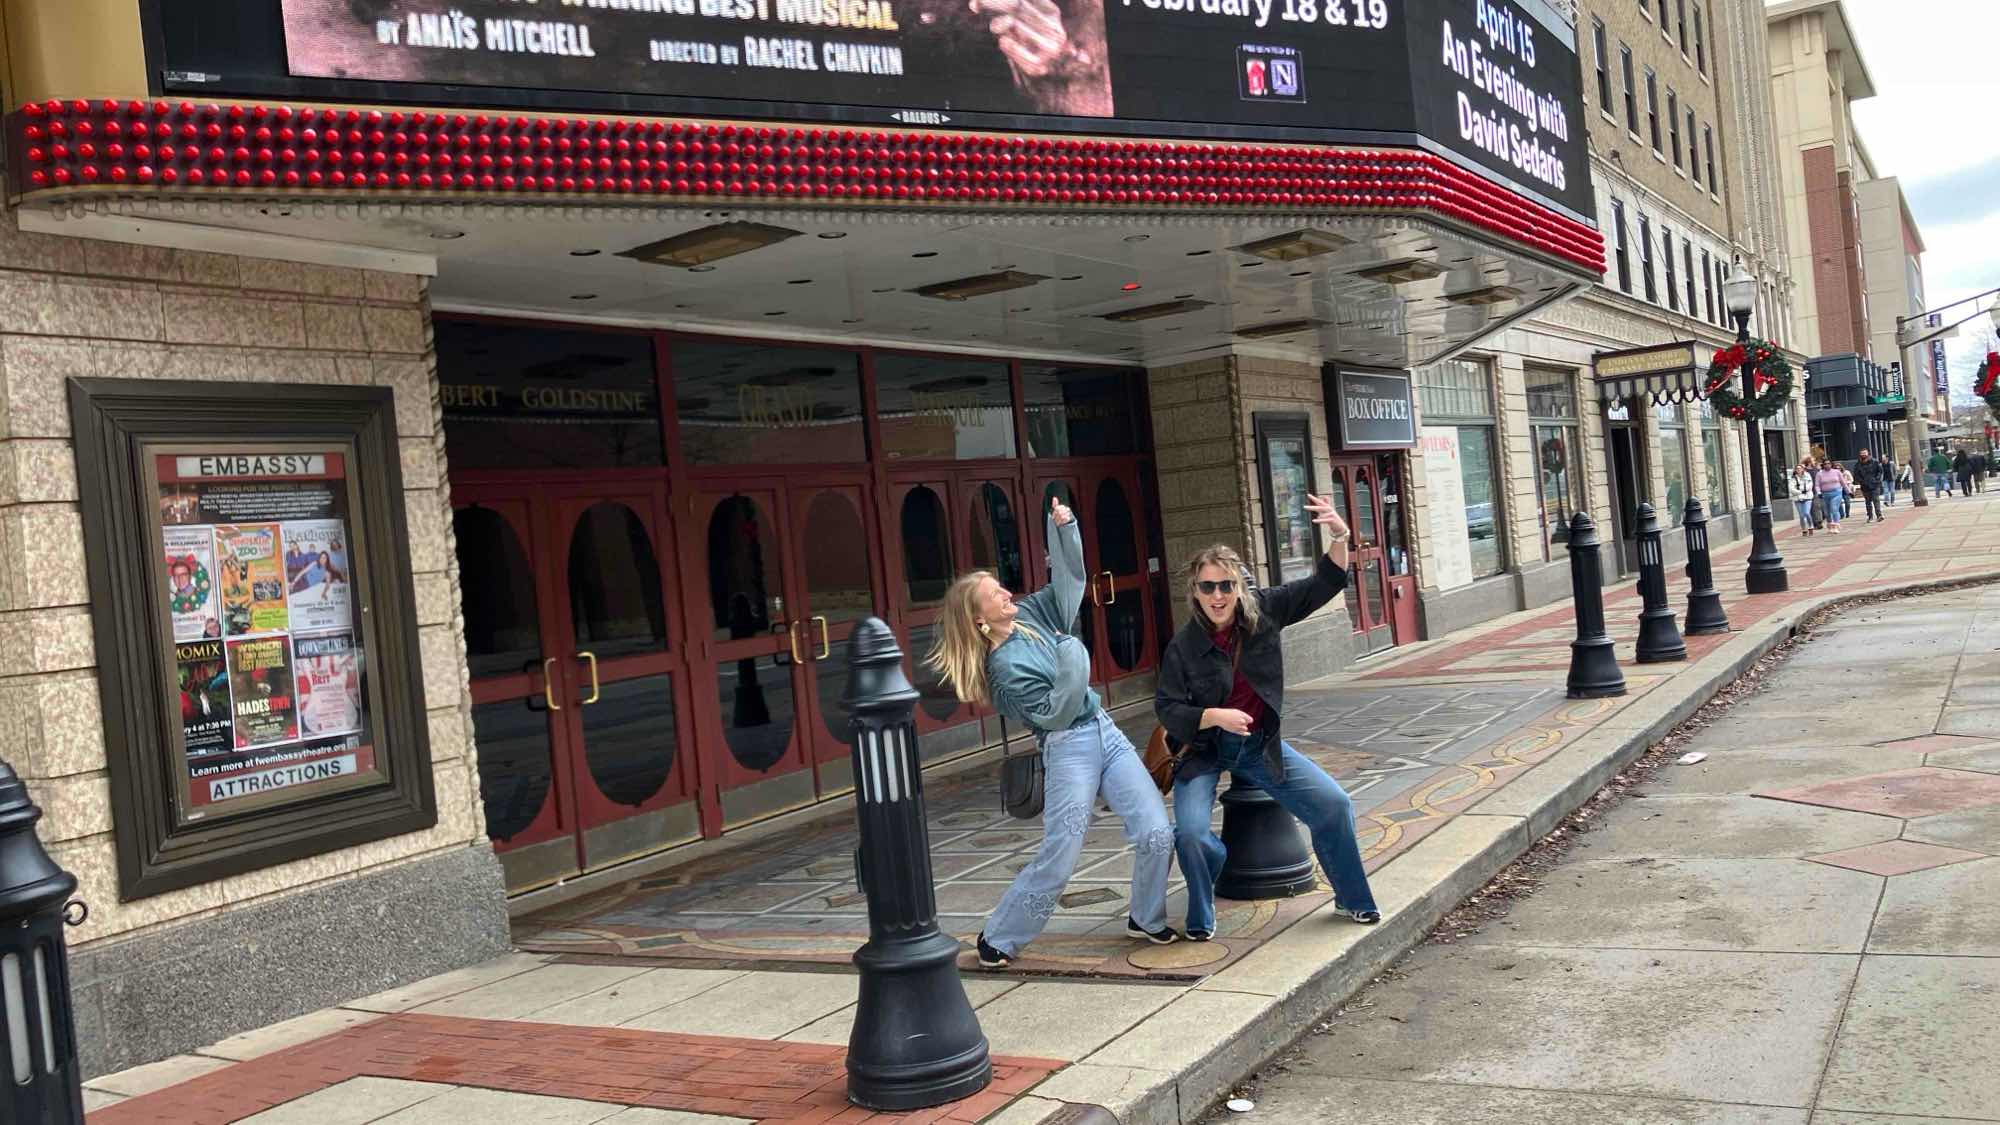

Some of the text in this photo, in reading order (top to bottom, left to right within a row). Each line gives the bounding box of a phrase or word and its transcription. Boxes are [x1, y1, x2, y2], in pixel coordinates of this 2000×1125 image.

[701, 0, 768, 20] BEST
[777, 0, 899, 30] MUSICAL
[1282, 0, 1318, 22] 18
[1325, 0, 1347, 26] &
[1354, 0, 1388, 29] 19
[406, 9, 479, 49] ANAÏS
[485, 18, 595, 56] MITCHELL
[1477, 0, 1536, 68] April 15
[744, 35, 818, 70] RACHEL
[1443, 19, 1568, 143] An Evening with
[1457, 90, 1566, 192] David Sedaris
[521, 386, 648, 411] GOLDSTINE
[1347, 397, 1408, 420] BOX OFFICE
[199, 456, 314, 476] EMBASSY
[191, 766, 219, 777] Learn
[221, 762, 243, 773] more
[245, 759, 254, 768] at
[213, 761, 341, 799] ATTRACTIONS
